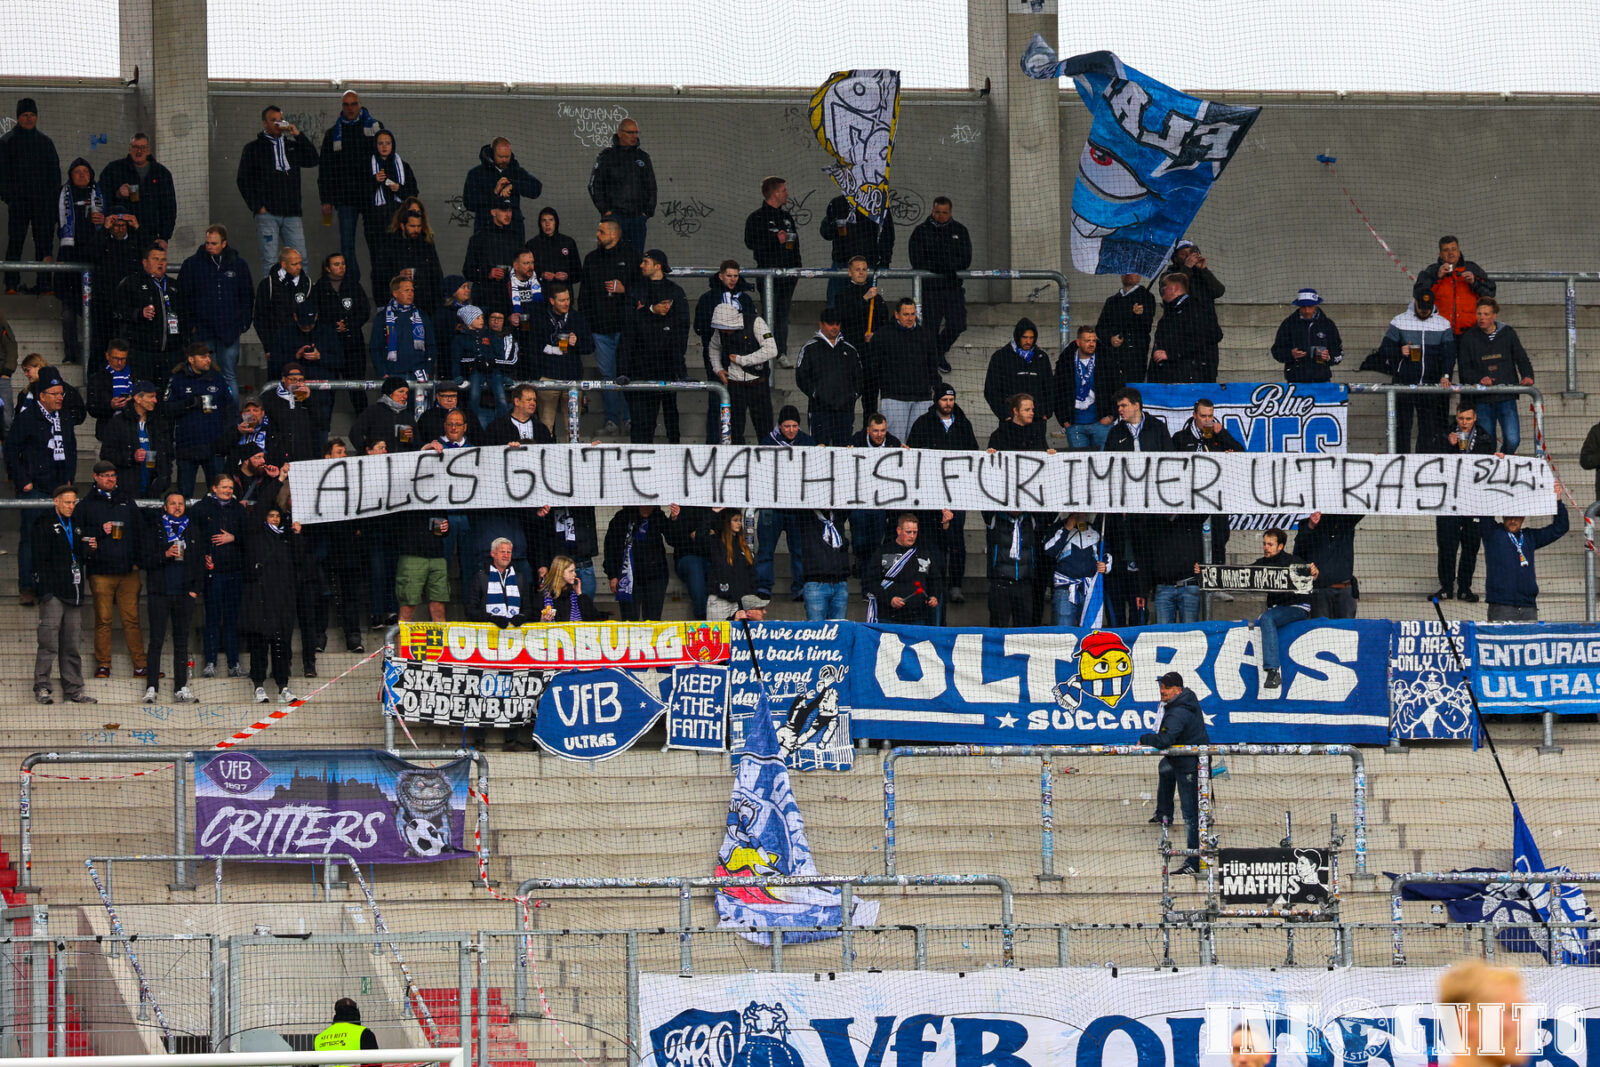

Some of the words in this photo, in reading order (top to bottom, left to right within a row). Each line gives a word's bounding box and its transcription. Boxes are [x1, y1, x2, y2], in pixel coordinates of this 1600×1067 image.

[577, 119, 619, 134] JUGEN
[1245, 384, 1315, 417] Blue
[315, 447, 481, 516] ALLES
[503, 446, 661, 500] GUTE
[682, 447, 921, 506] MATHIS!
[941, 453, 1046, 508] FÜR
[1062, 455, 1223, 511] IMMER
[1250, 454, 1461, 511] ULTRAS!
[1221, 568, 1251, 588] IMMER
[1254, 568, 1288, 589] MATHIS
[770, 627, 793, 640] we
[793, 624, 838, 641] could
[1400, 620, 1420, 636] NO
[447, 626, 684, 661] OLDENBURG
[766, 645, 806, 662] back
[806, 645, 843, 662] time,
[1398, 637, 1416, 654] NO
[875, 627, 1360, 704] ULTRAS
[1398, 654, 1433, 672] ONLY
[678, 674, 722, 695] KEEP
[731, 668, 748, 684] to
[774, 668, 812, 688] good
[403, 692, 539, 719] OLDENBUR
[552, 681, 622, 727] VfB
[681, 696, 714, 718] THE
[672, 718, 721, 741] FAITH
[1028, 709, 1159, 731] SUCCAD
[564, 733, 617, 751] ULTRAS
[219, 760, 251, 779] VfB
[200, 802, 386, 856] CRITTERS
[1223, 860, 1248, 876] FÜR
[1250, 862, 1297, 876] IMMER
[1223, 876, 1301, 896] MATHIS
